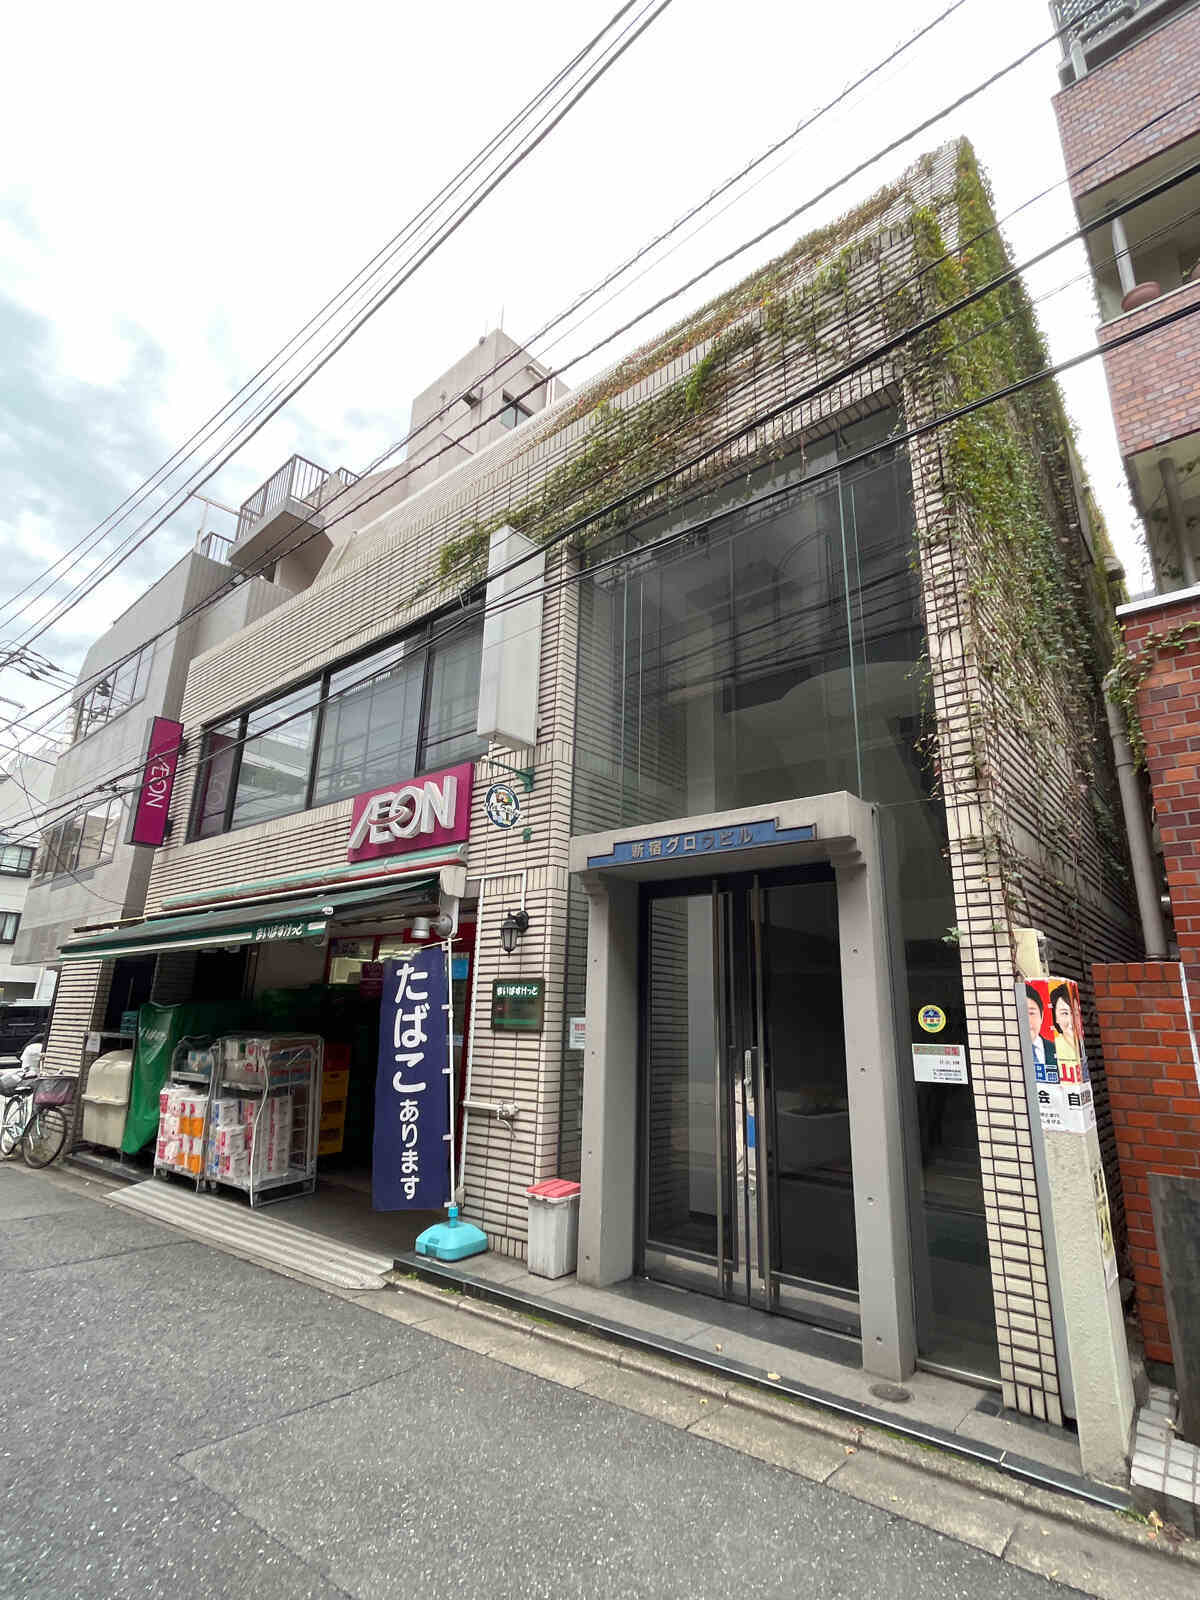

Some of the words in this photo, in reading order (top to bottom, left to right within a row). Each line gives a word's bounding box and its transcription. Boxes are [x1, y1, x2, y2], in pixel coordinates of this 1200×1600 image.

[496, 986, 539, 996] まいばすけっと
